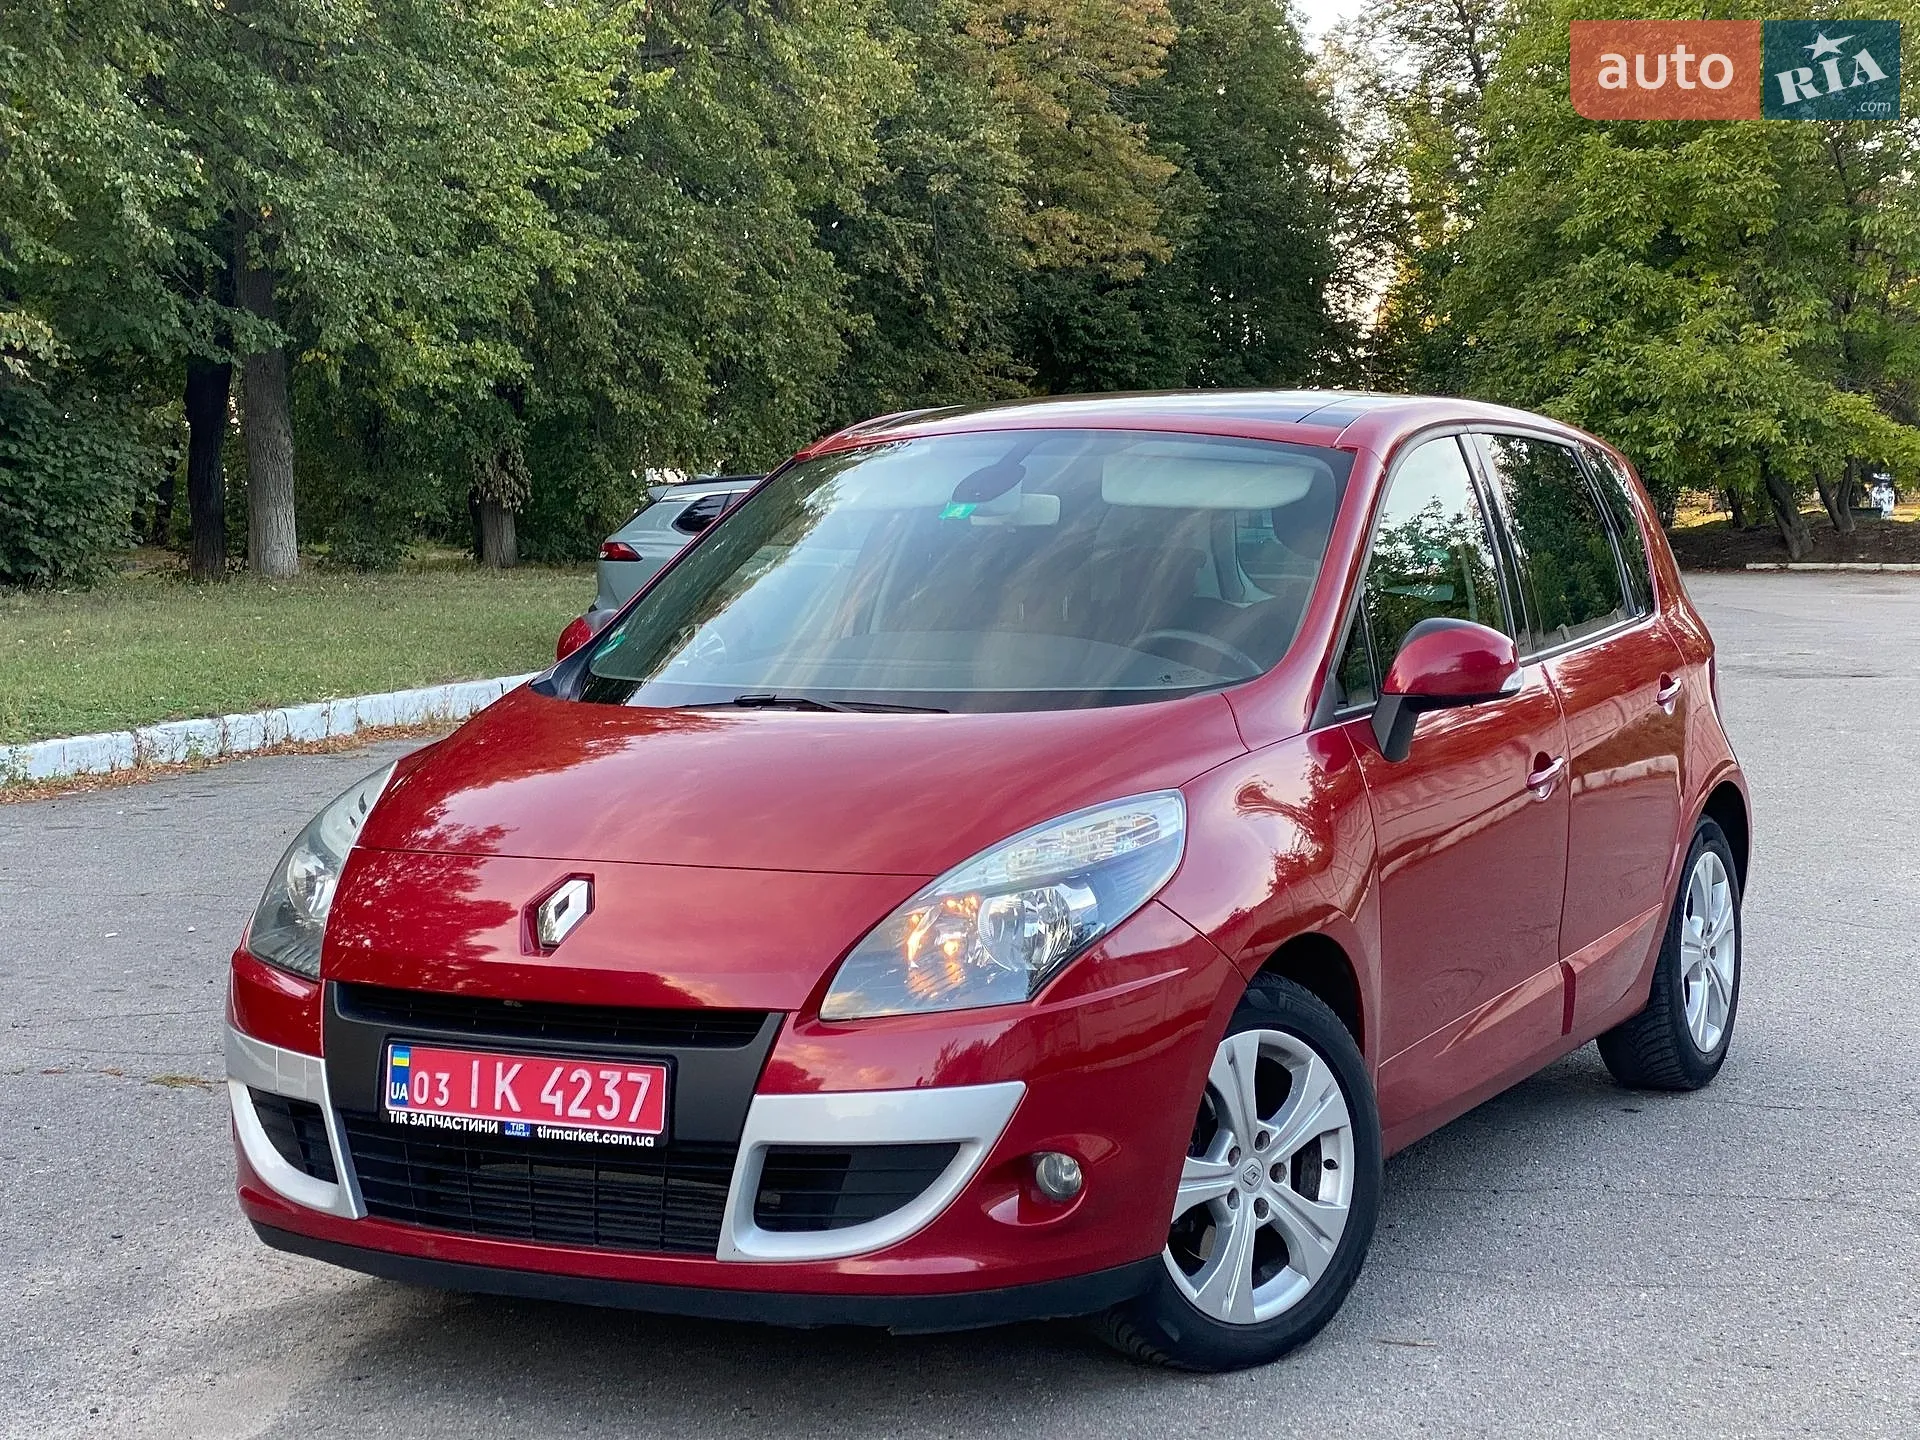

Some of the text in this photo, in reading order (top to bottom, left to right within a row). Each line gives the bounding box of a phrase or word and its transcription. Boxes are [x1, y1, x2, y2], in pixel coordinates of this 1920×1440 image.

[390, 1082, 409, 1101] UA
[412, 1070, 451, 1108] 03
[540, 1066, 651, 1123] 4237
[389, 1110, 499, 1134] TIR ЗАПЧАСТИНИ
[510, 1122, 525, 1132] TIR
[505, 1129, 530, 1137] MARKET
[536, 1125, 655, 1147] tirmarket.com.ua
